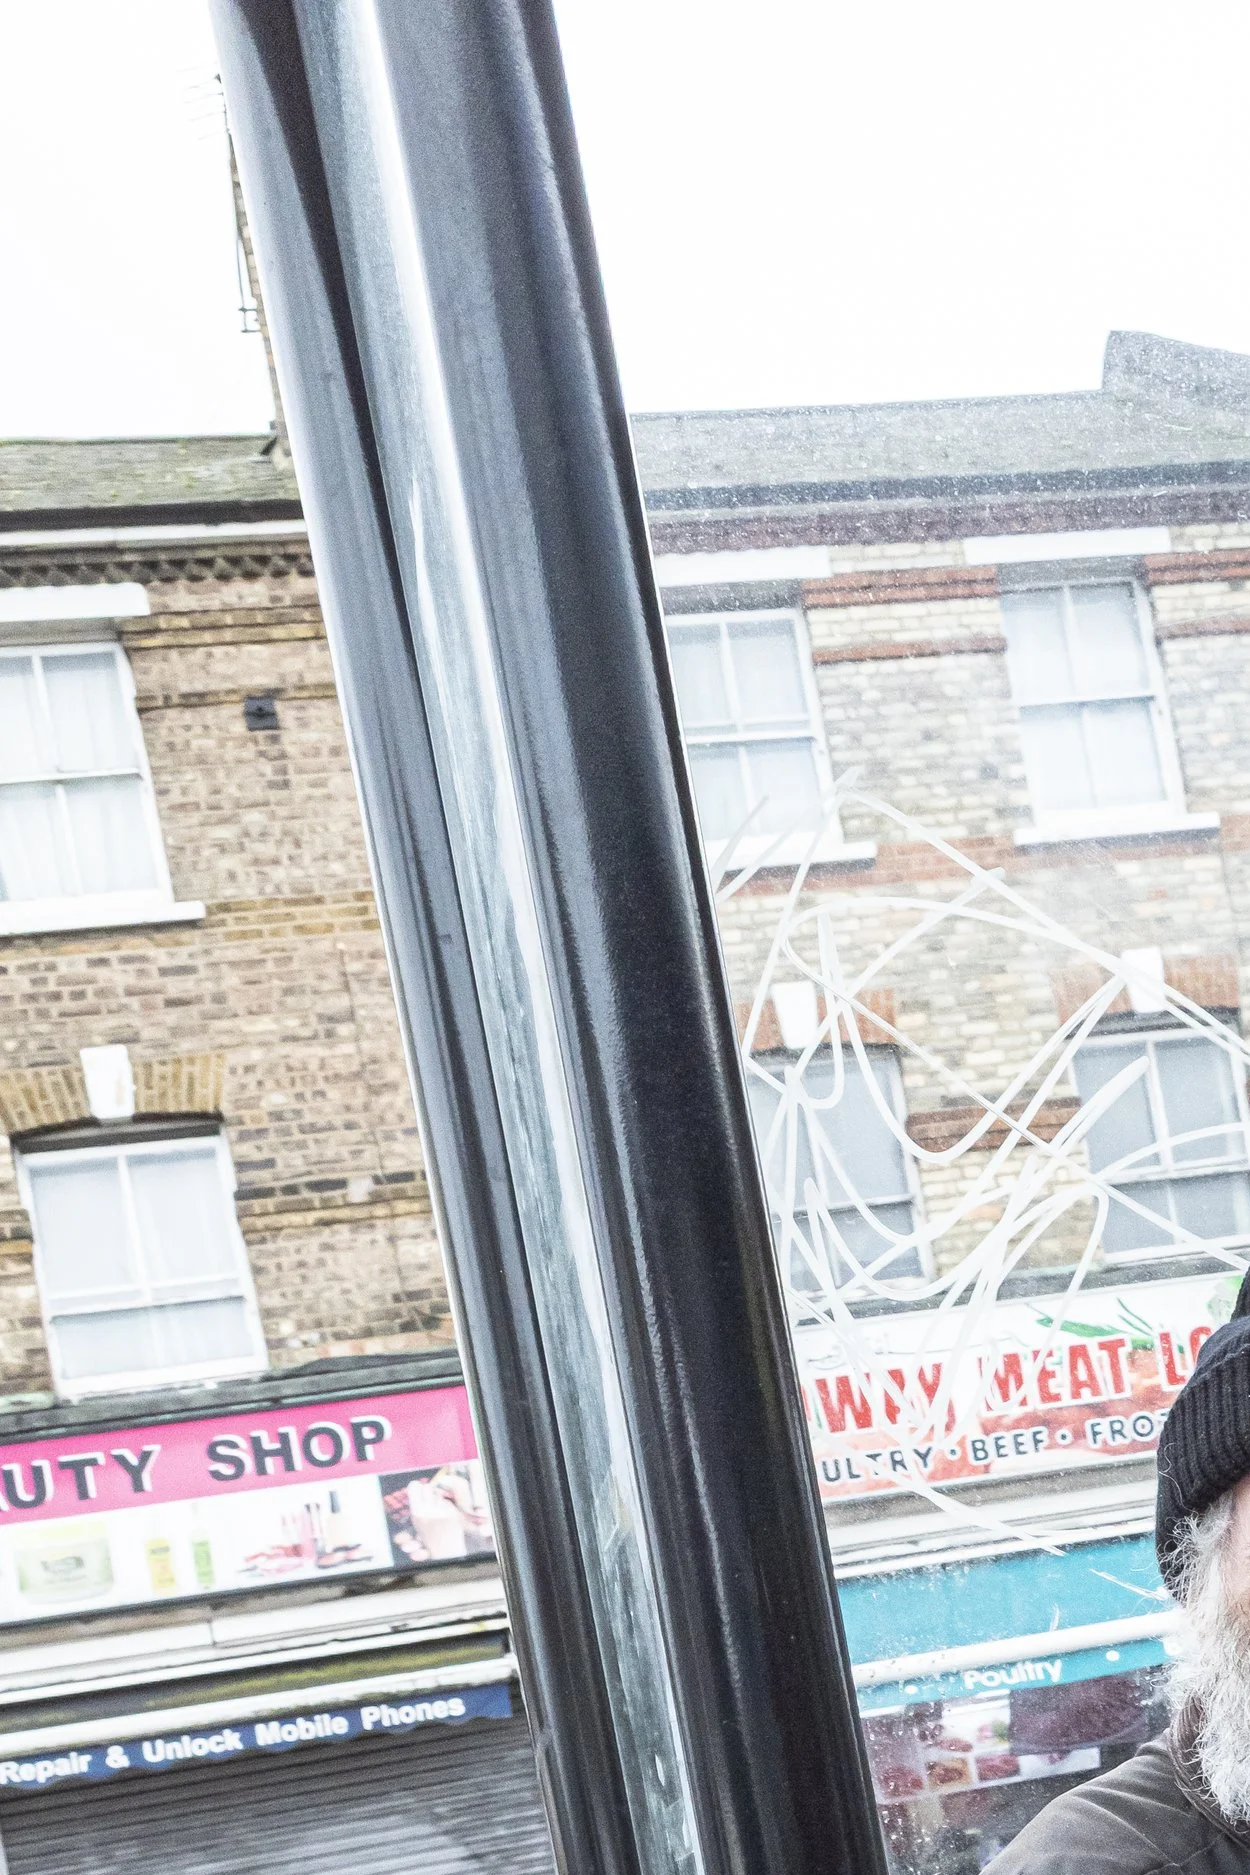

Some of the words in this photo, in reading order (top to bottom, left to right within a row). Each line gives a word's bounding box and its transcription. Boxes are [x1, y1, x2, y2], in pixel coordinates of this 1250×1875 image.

[978, 1338, 1126, 1412] MEAT
[0, 1444, 161, 1511] UTY
[206, 1414, 392, 1483] SHOP
[970, 1429, 1046, 1463] BEEF
[1090, 1411, 1168, 1445] FRO
[0, 1752, 92, 1785] Repair
[105, 1745, 129, 1770] &
[142, 1727, 244, 1763] Unlock
[255, 1714, 349, 1748] Mobile
[361, 1695, 466, 1730] Phones
